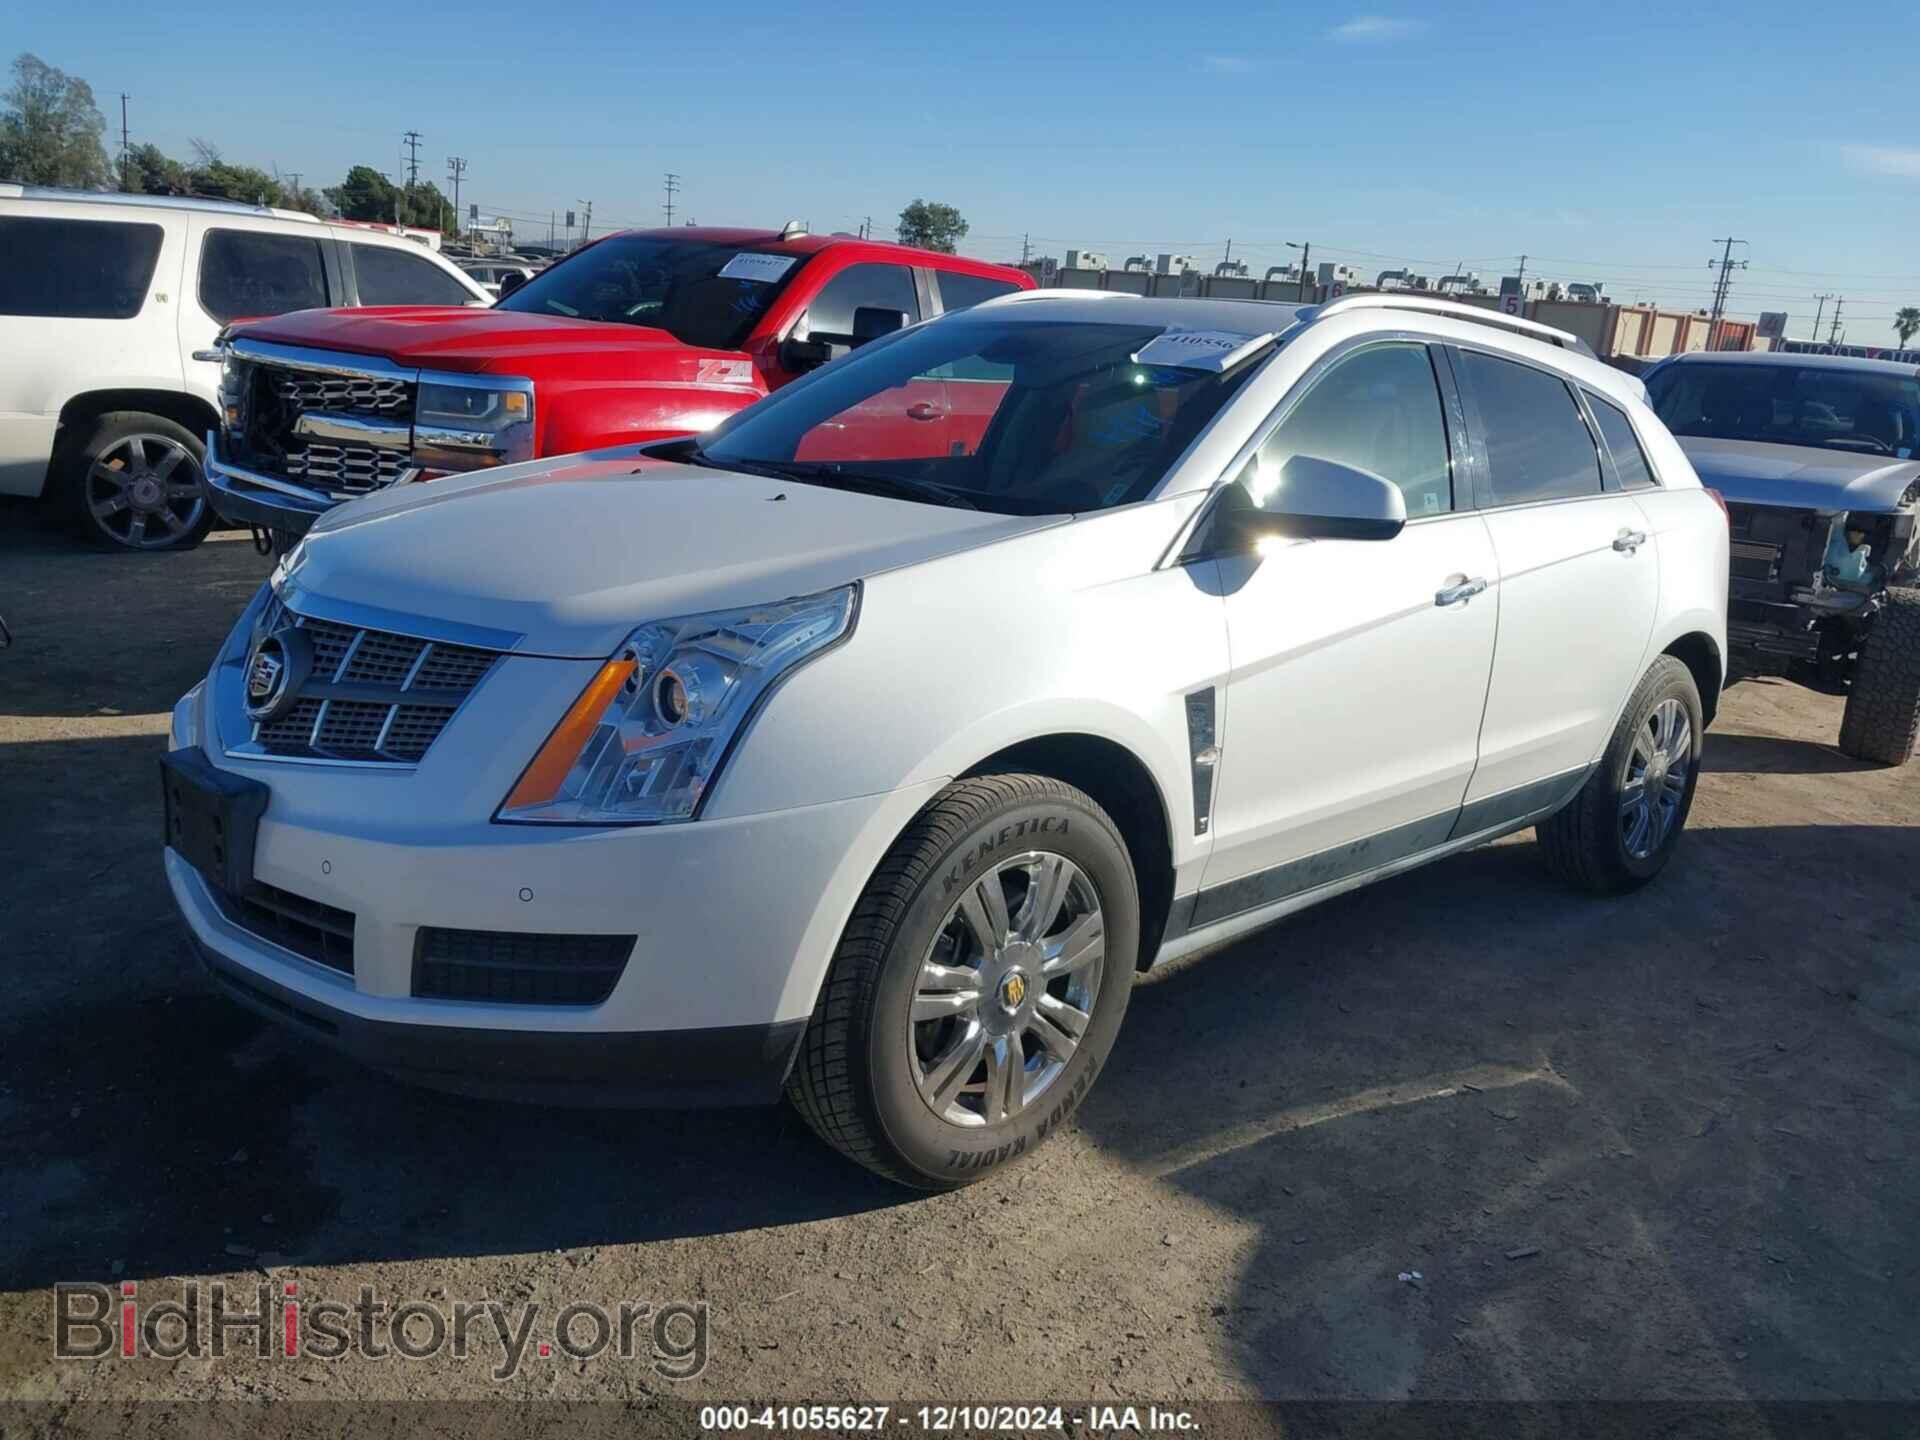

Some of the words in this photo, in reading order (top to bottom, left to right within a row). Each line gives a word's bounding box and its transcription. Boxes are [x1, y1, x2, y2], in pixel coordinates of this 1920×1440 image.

[1505, 296, 1518, 315] 5
[943, 816, 1070, 892] KENETICA
[944, 1135, 1026, 1169] RADIAL
